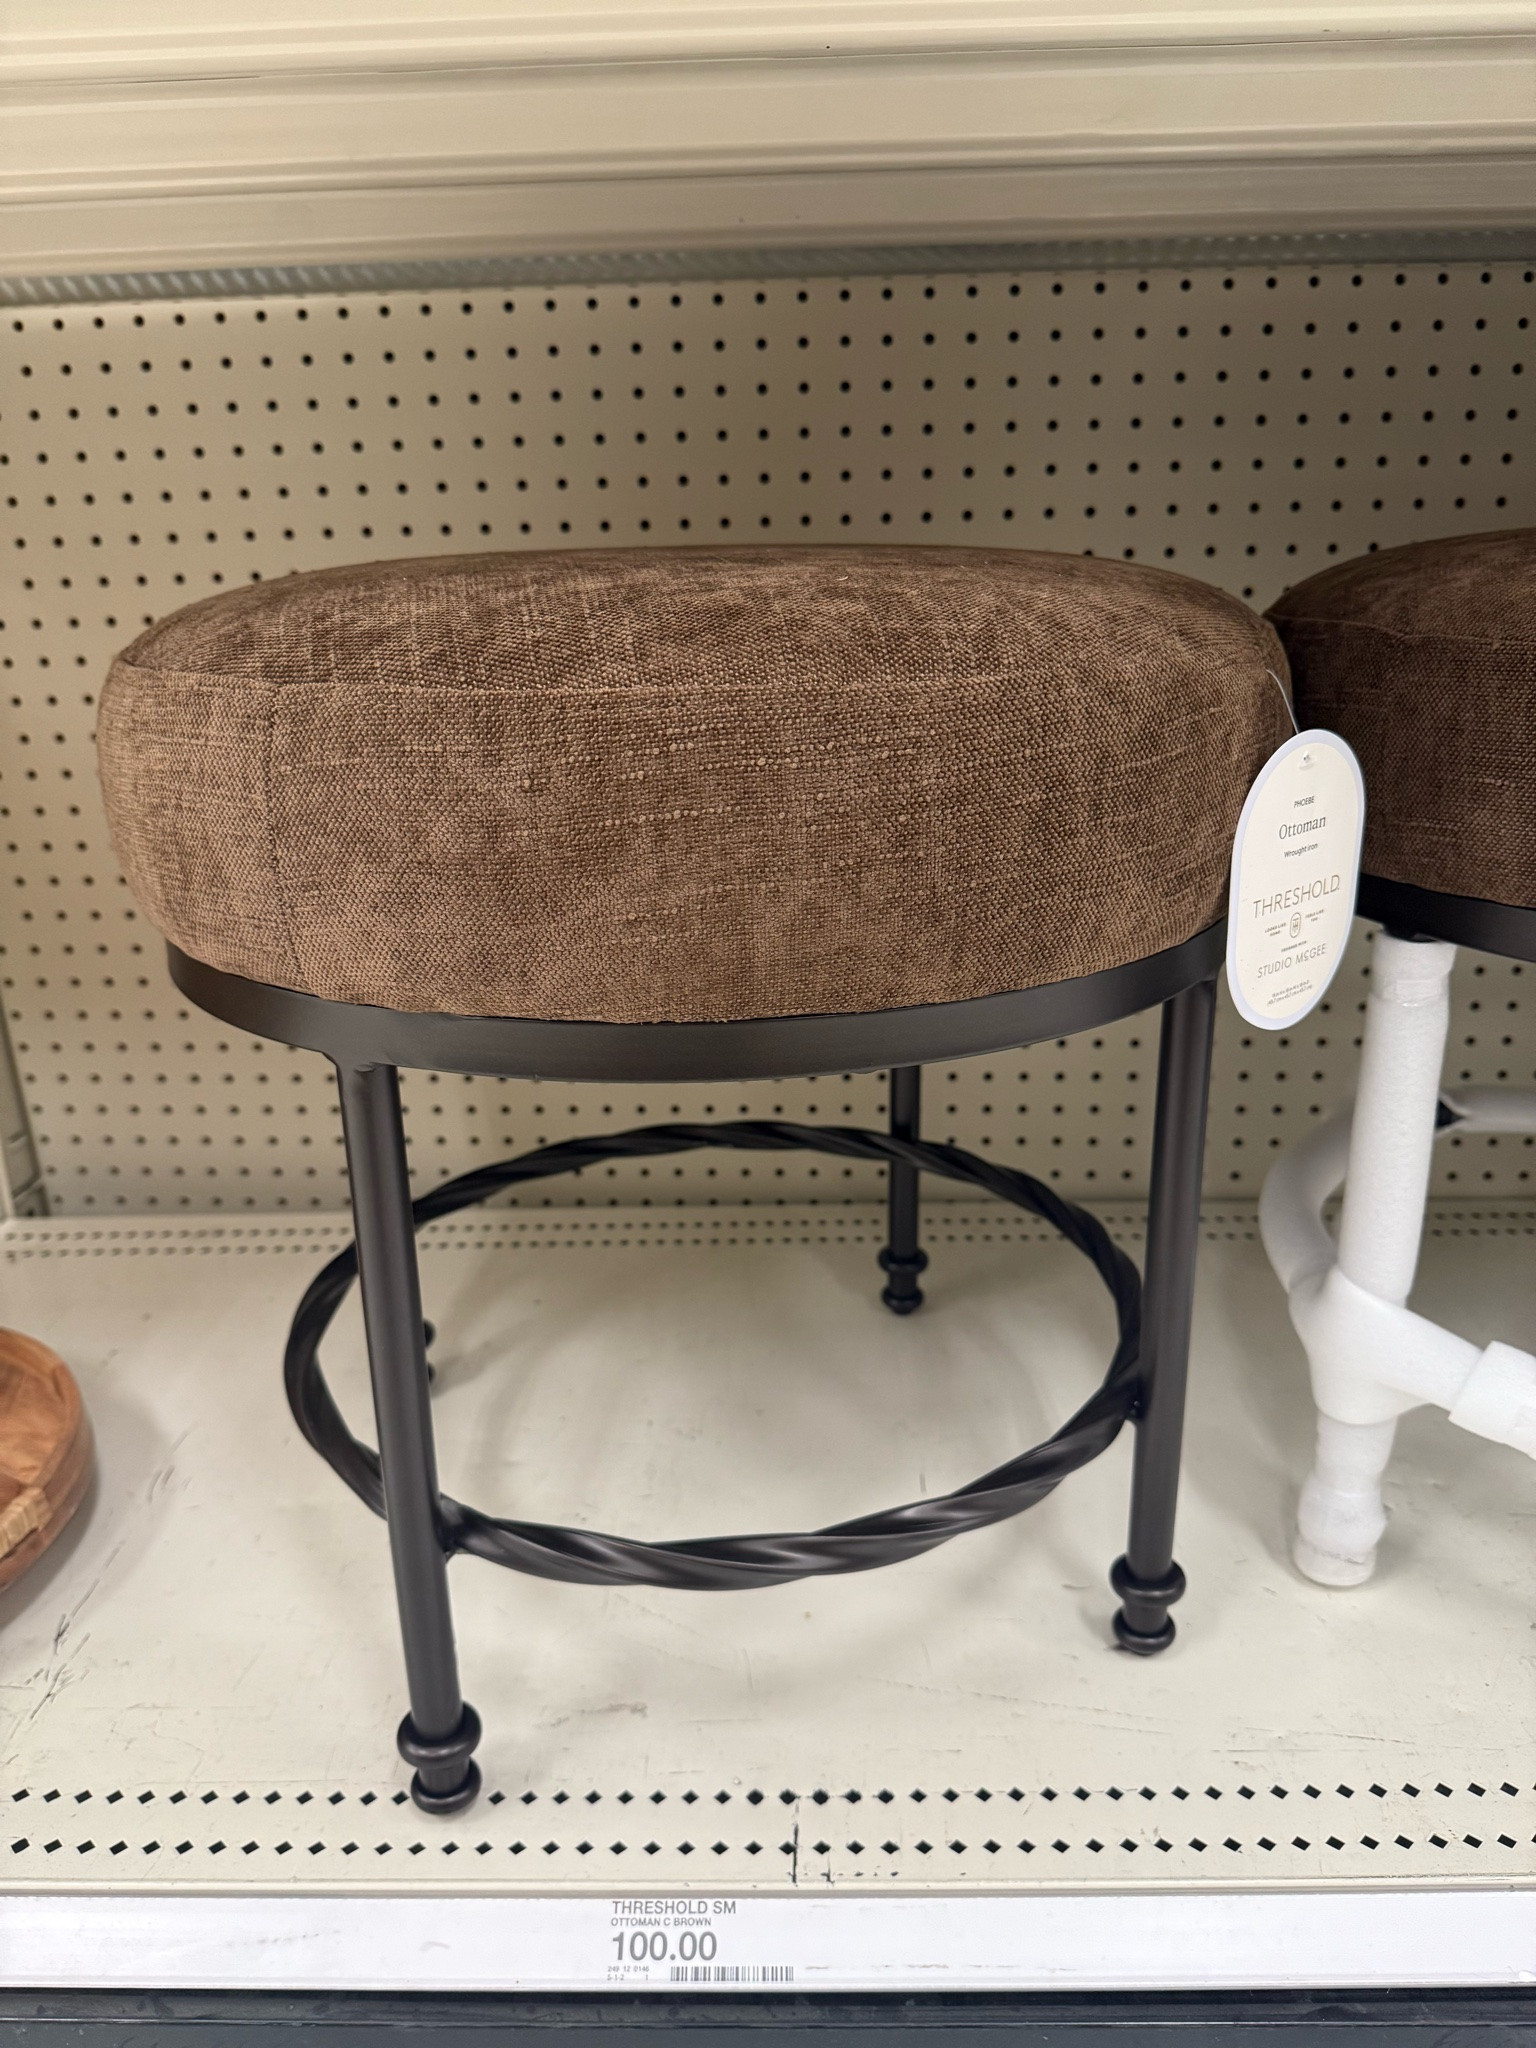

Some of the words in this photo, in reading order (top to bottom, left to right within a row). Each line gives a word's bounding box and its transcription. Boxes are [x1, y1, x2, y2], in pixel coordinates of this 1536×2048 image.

[1293, 795, 1315, 809] PHOEBE
[1278, 817, 1327, 840] Ottoman
[1284, 847, 1307, 858] Wrought
[1307, 843, 1318, 853] iron
[1257, 957, 1292, 979] STUDIO
[612, 1900, 708, 1915] THRESHOLD
[713, 1900, 736, 1915] SM
[611, 1917, 660, 1927] OTTOMAN
[663, 1917, 671, 1927] C
[673, 1917, 712, 1927] BROWN
[612, 1931, 718, 1961] 100.00
